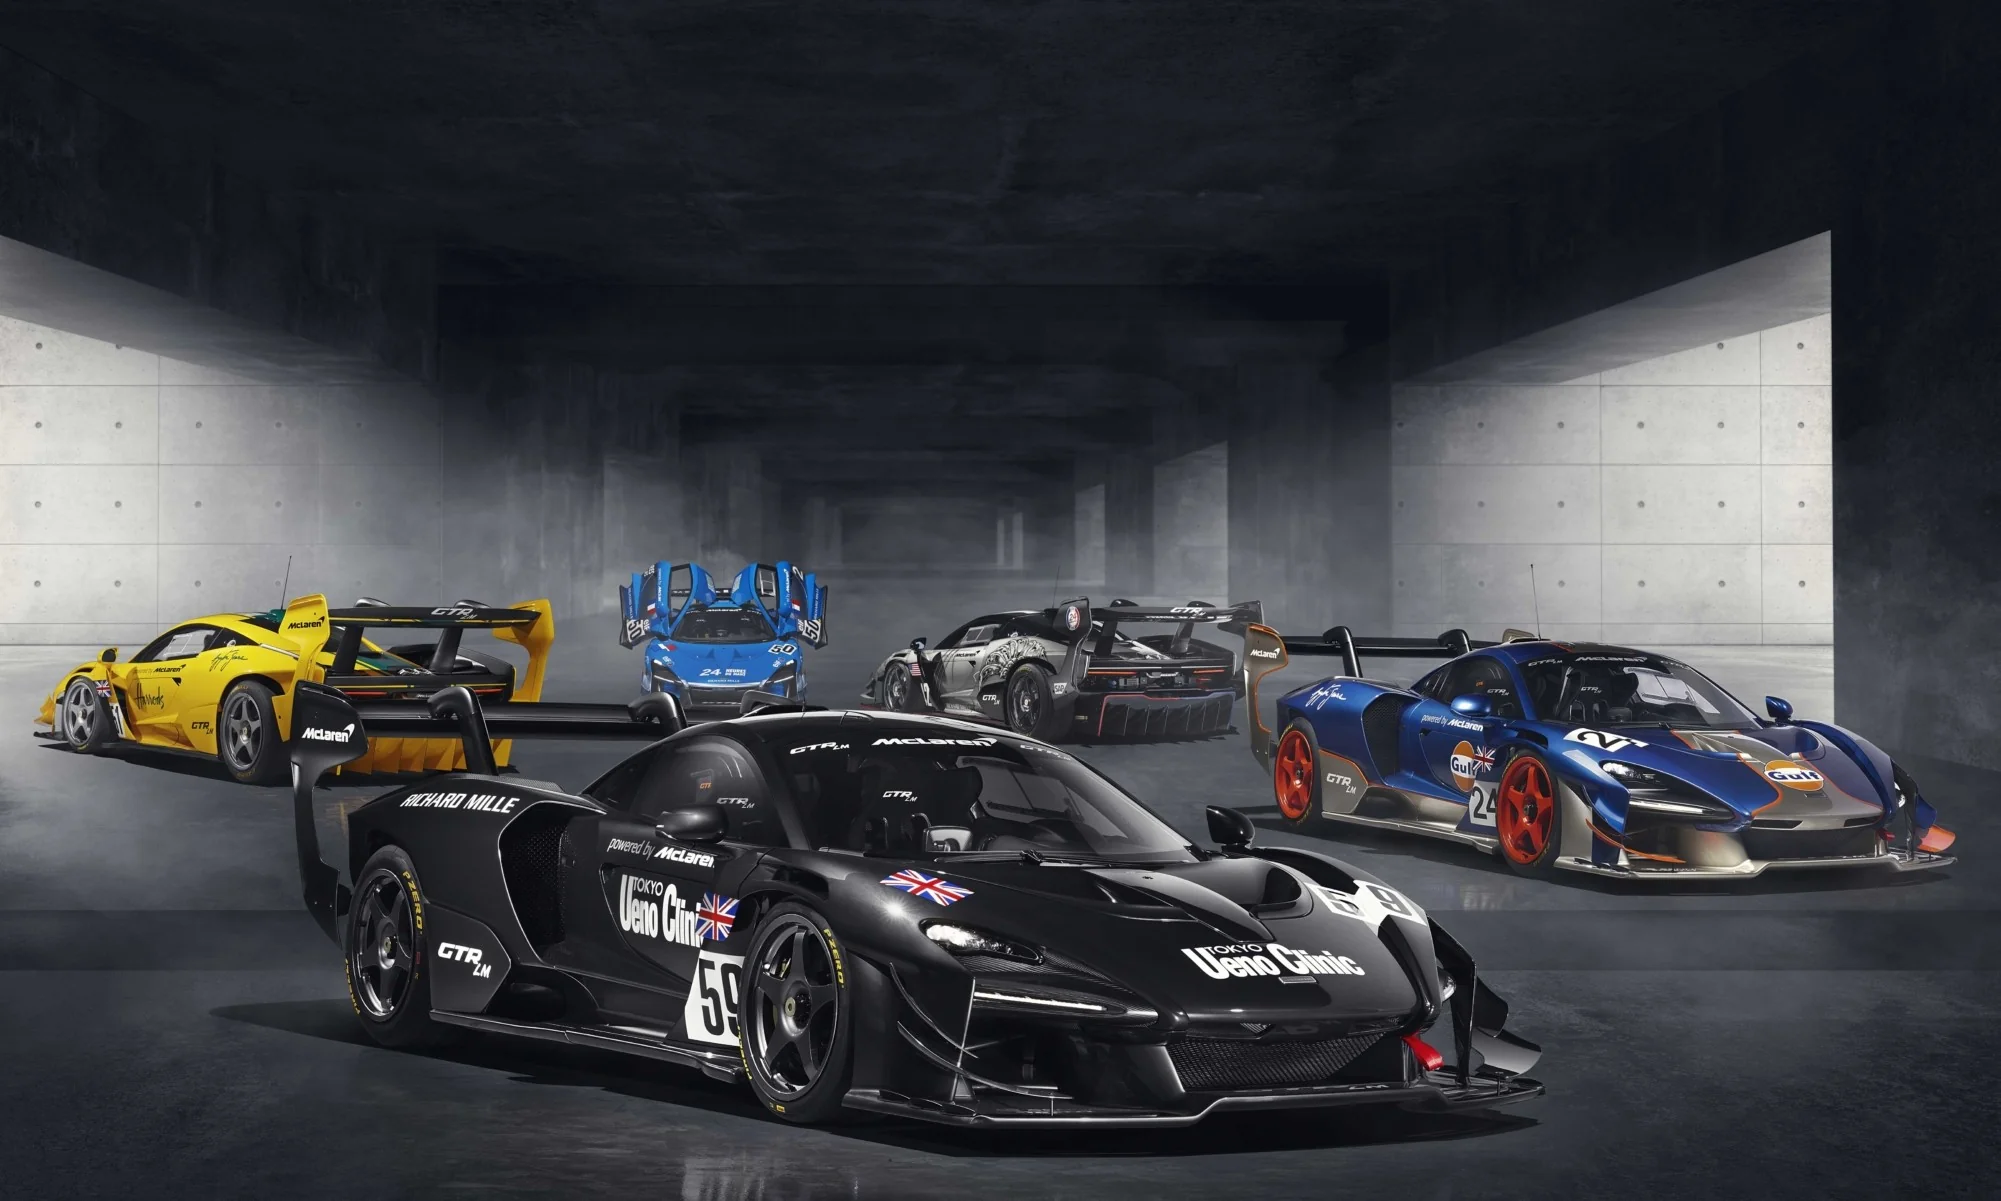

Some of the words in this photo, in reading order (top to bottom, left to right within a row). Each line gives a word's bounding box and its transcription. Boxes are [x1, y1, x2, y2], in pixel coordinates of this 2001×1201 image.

[431, 607, 473, 616] GTR
[1169, 606, 1204, 614] GTR
[288, 616, 325, 629] McLaren
[770, 644, 795, 654] 50
[1250, 647, 1281, 659] McLaren
[153, 664, 186, 673] McLaren
[1528, 659, 1556, 667] GTR
[699, 668, 722, 677] 24
[1054, 684, 1066, 693] SAP
[191, 721, 210, 730] GTR
[1421, 714, 1443, 724] powered
[1447, 718, 1484, 732] McLaren
[302, 723, 355, 743] McLaren
[790, 741, 837, 755] GTR
[871, 737, 998, 747] McLaren
[1767, 769, 1822, 783] Gulf
[1326, 772, 1352, 786] GTR
[1346, 785, 1356, 795] LM
[882, 790, 913, 798] GTR
[400, 792, 468, 809] RICHARD
[463, 793, 521, 814] MILLE
[716, 797, 749, 805] GTR
[606, 838, 647, 854] powered
[643, 840, 656, 861] by
[633, 876, 664, 897] TOKYO
[620, 874, 659, 938] Ueno
[662, 883, 704, 948] Clini
[1204, 944, 1263, 954] TOKYO
[437, 941, 483, 965] GTR
[472, 962, 492, 979] LM
[1181, 947, 1281, 980] Ueno
[1265, 943, 1366, 976] Clinic
[699, 957, 743, 1039] 59
